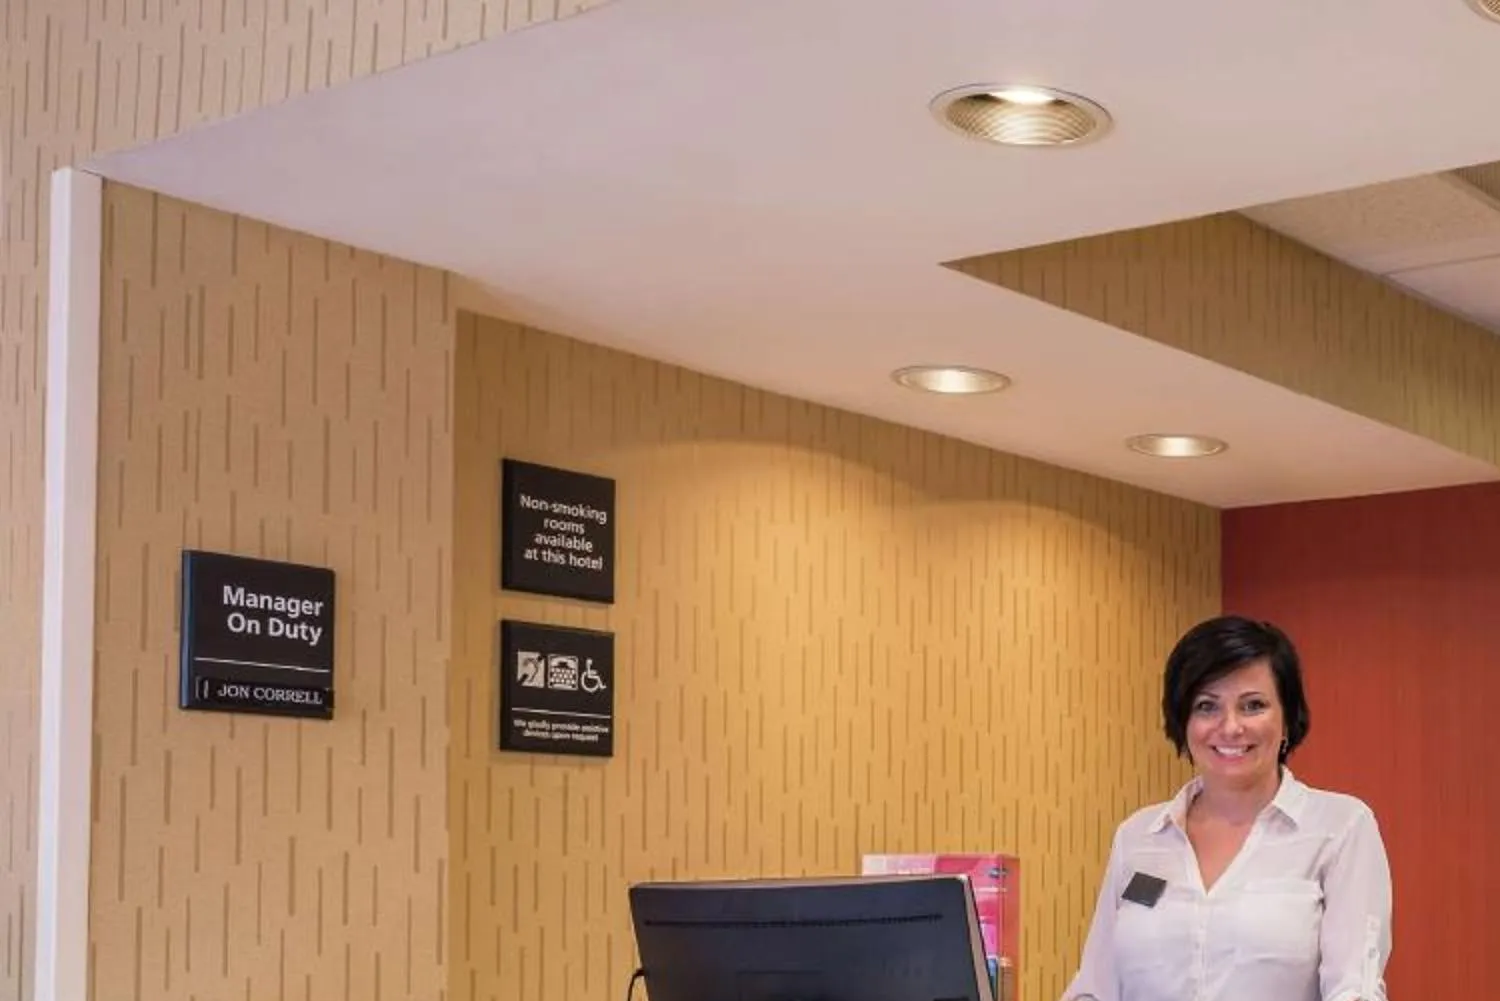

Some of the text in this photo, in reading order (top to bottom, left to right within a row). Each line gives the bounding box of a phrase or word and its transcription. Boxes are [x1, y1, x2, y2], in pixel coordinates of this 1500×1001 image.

[520, 494, 607, 525] Non-smoking
[543, 518, 585, 535] rooms
[534, 533, 593, 553] available
[523, 548, 603, 570] at this hotel
[223, 585, 324, 618] Manager
[227, 612, 322, 646] On Duty
[217, 684, 323, 705] JON CORRELL
